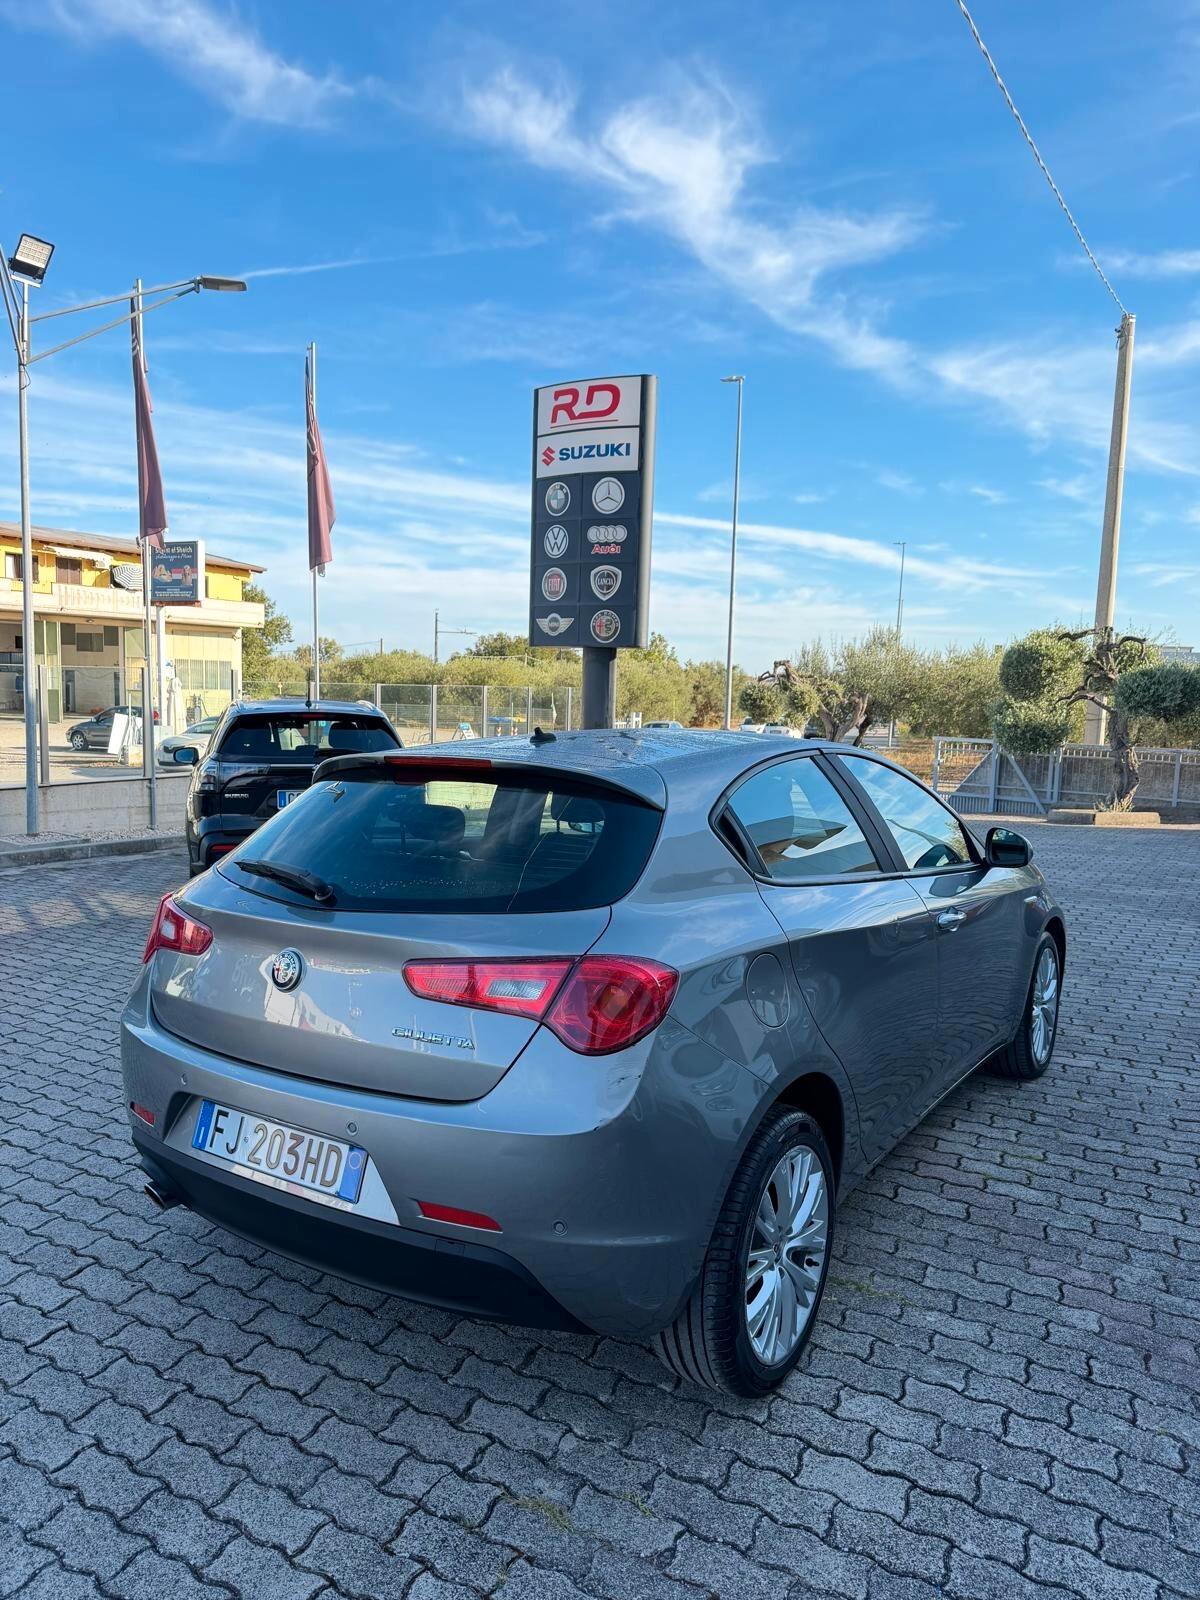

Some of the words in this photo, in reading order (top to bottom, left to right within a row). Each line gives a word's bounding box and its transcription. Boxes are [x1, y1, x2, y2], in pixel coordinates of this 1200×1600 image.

[550, 383, 621, 424] RD
[558, 443, 631, 461] SUZUKI
[591, 544, 621, 554] Audi
[548, 578, 560, 592] FIAT
[597, 577, 614, 586] LANCIA
[391, 1026, 476, 1050] GIULIETTA
